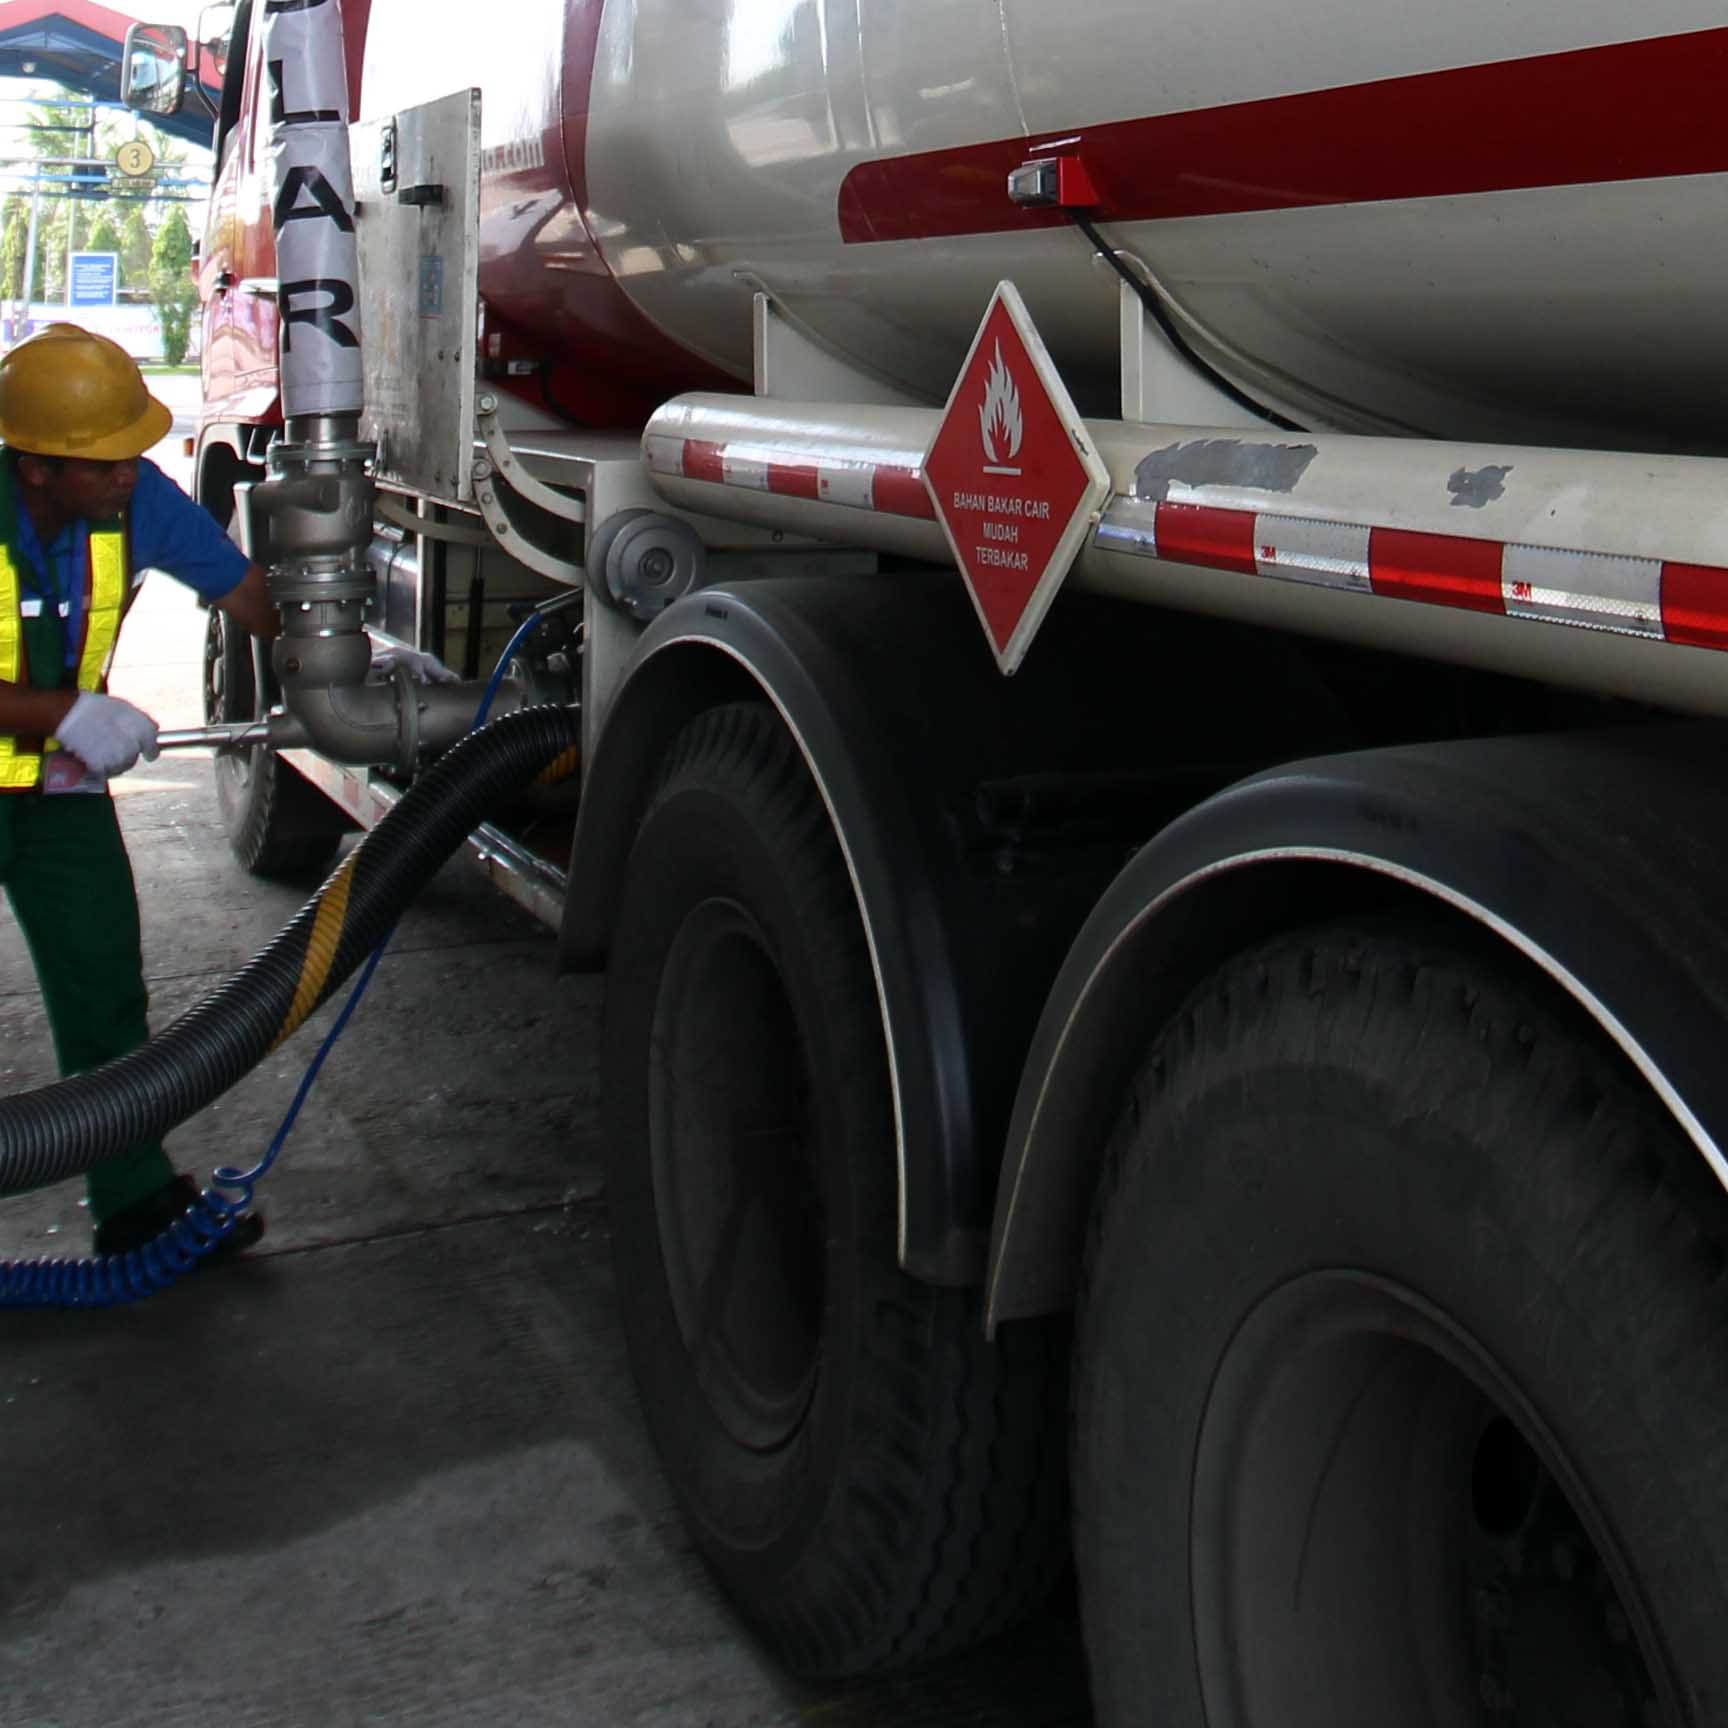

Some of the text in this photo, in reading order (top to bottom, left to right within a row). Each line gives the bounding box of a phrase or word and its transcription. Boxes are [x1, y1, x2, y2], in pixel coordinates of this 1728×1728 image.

[129, 148, 141, 169] 3
[953, 492, 1050, 520] BAHAN BAKAR CAIR
[983, 522, 1019, 545] MUDAH
[976, 546, 1029, 572] TERBAKAR
[1511, 580, 1532, 602] 3M
